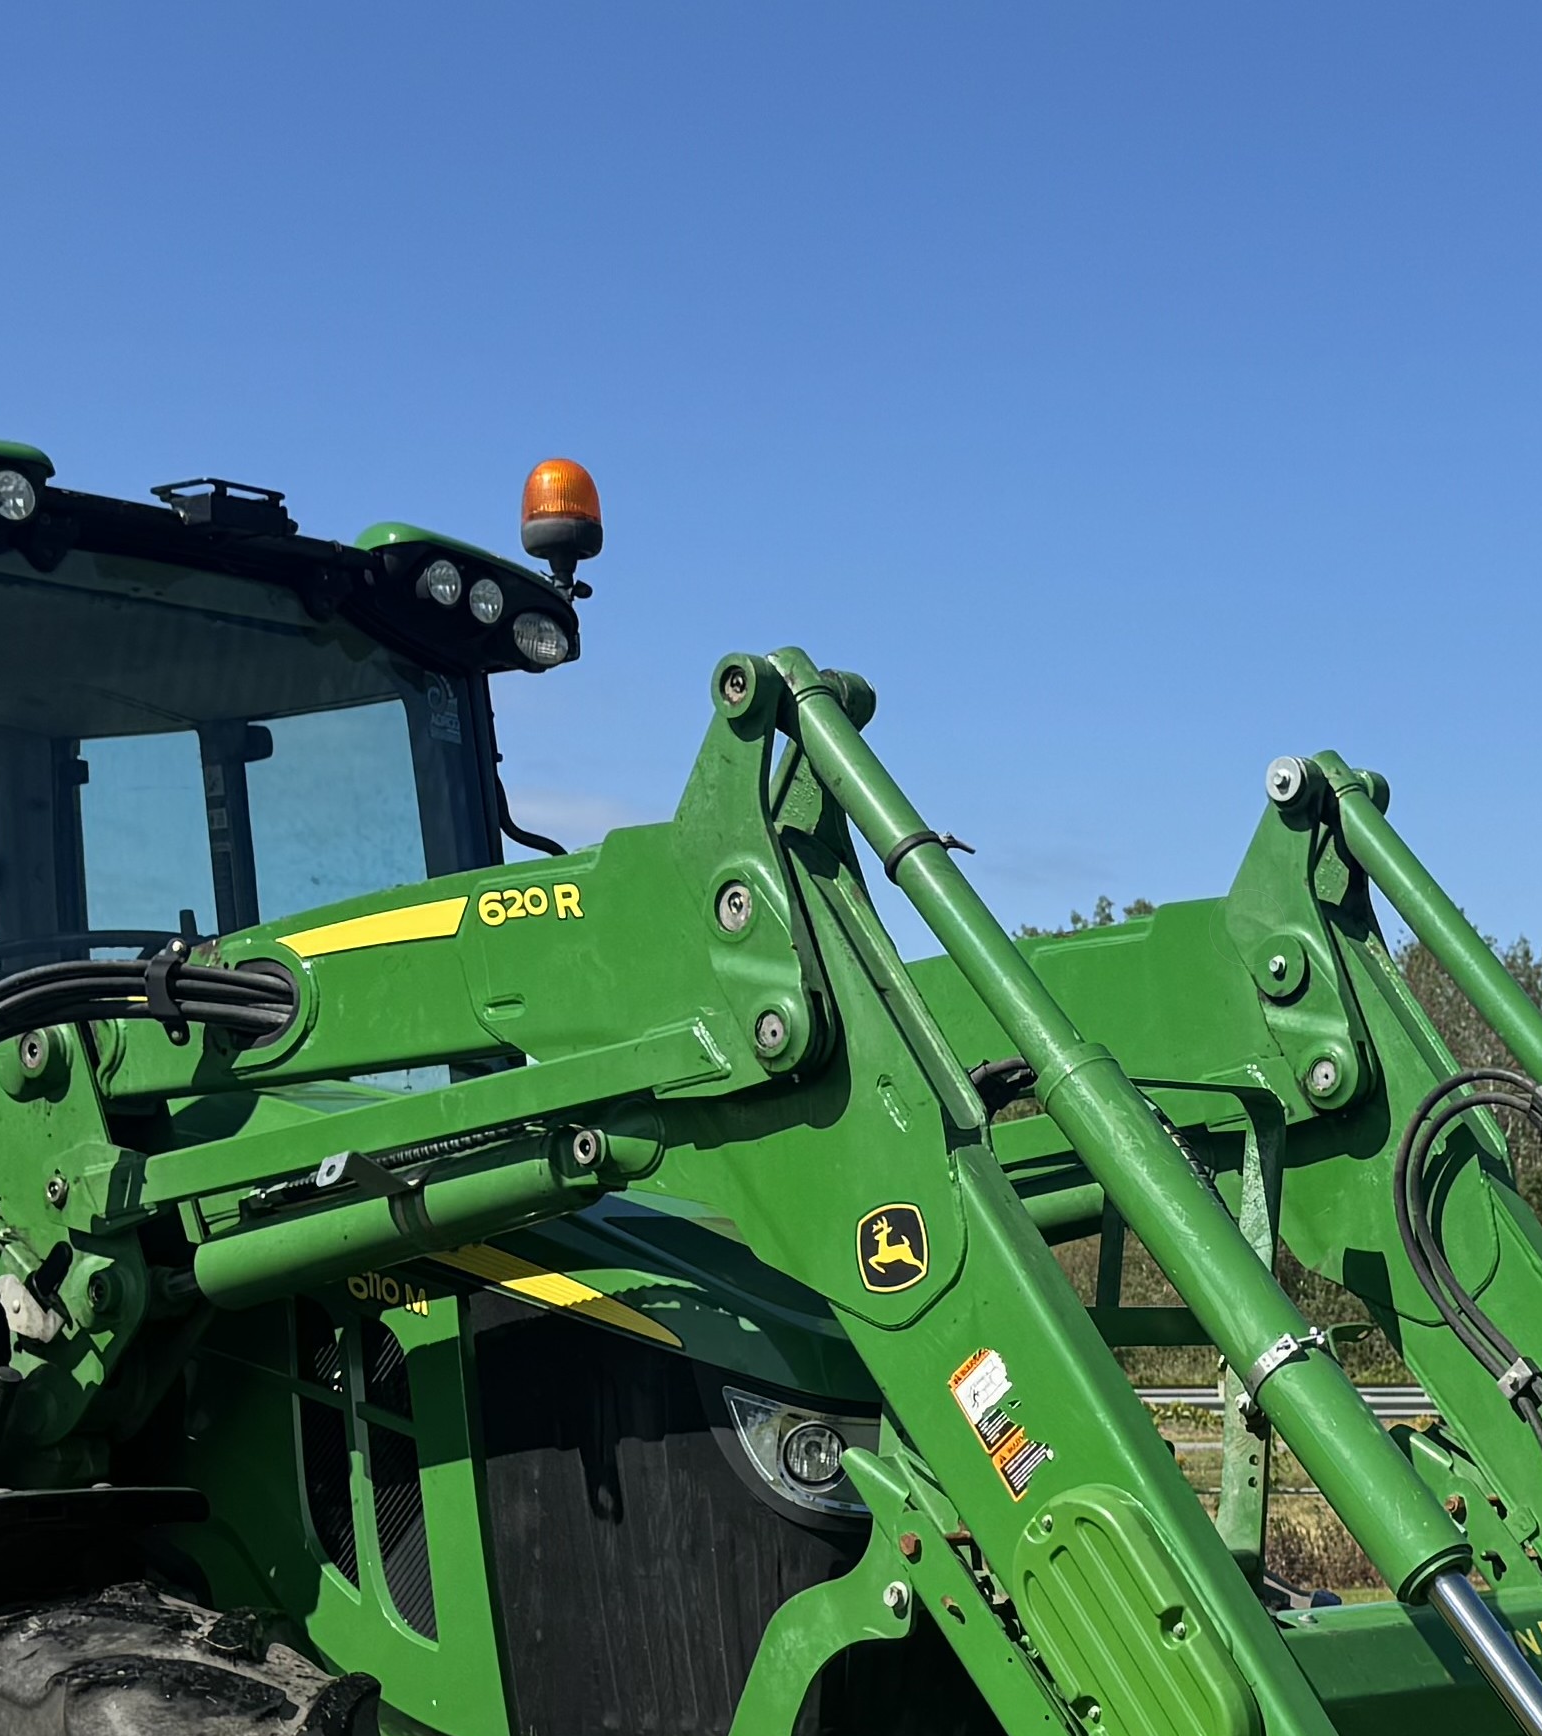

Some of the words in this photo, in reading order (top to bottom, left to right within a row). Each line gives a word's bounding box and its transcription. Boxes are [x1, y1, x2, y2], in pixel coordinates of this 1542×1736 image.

[477, 884, 549, 928] 620
[551, 881, 586, 921] R
[404, 1282, 429, 1318] M
